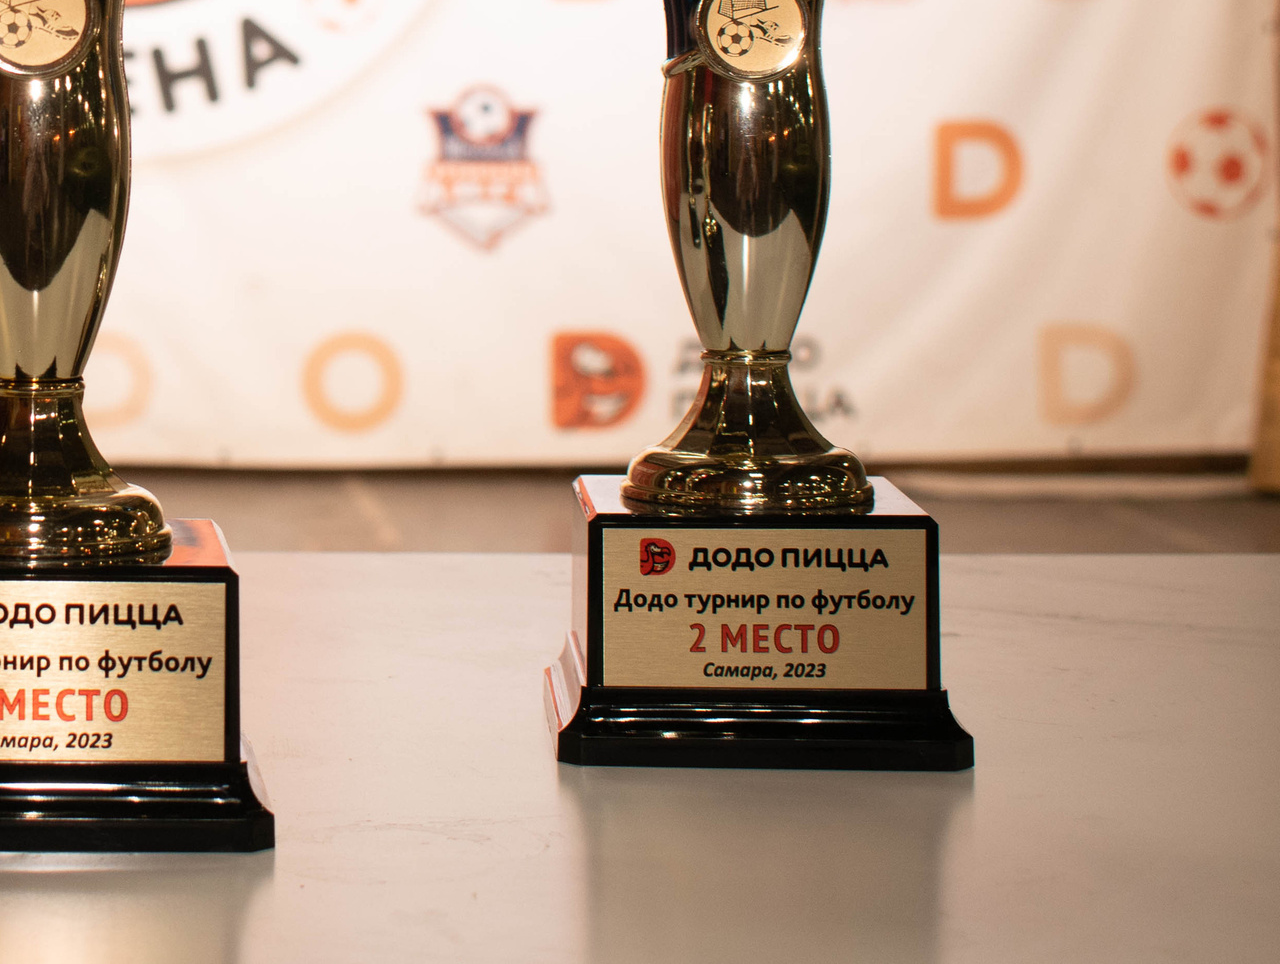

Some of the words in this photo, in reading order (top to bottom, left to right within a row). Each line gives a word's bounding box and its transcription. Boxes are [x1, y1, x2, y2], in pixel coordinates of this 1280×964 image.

[688, 547, 774, 571] ДОДО
[782, 548, 889, 572] ПИЦЦА
[614, 588, 678, 612] Додо
[684, 591, 770, 614] турнир
[777, 593, 805, 609] по
[811, 589, 915, 615] футболу
[65, 603, 184, 630] ПИЦЦА
[690, 623, 706, 653] 2
[721, 623, 840, 654] МЕСТО
[59, 655, 90, 671] по
[97, 650, 212, 679] футболу
[702, 662, 778, 681] Самара,
[783, 663, 827, 679] 2023
[65, 732, 113, 749] 2023
